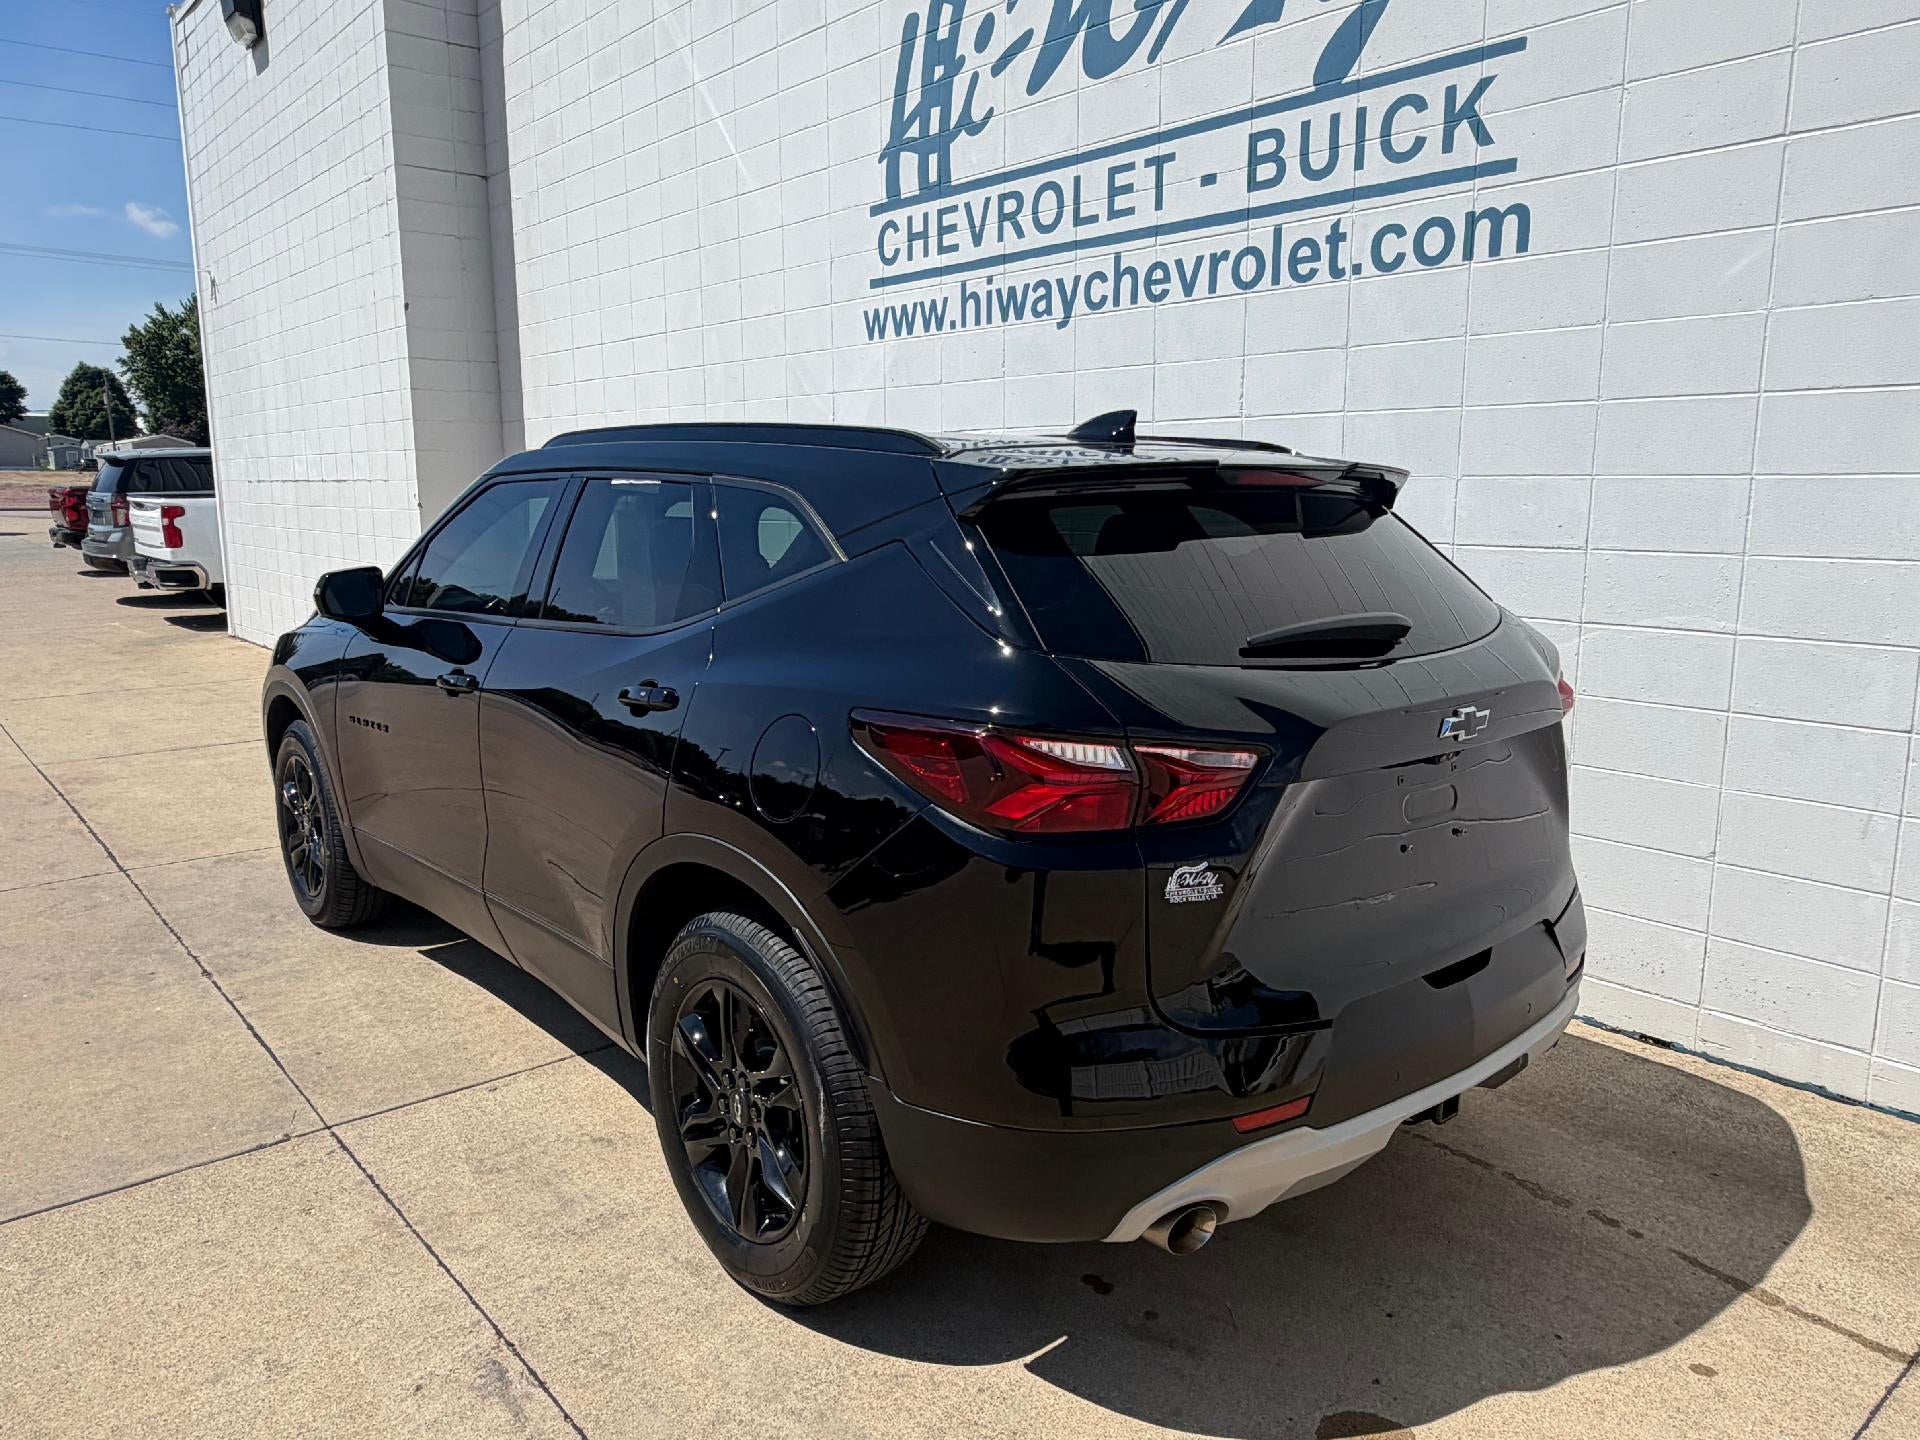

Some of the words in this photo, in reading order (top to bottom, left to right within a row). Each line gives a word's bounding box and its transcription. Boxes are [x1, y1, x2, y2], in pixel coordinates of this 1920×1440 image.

[878, 152, 1177, 267] CHEVROLET
[1247, 75, 1498, 193] BUICK
[863, 203, 1531, 341] www.hiwaychevrolet.com
